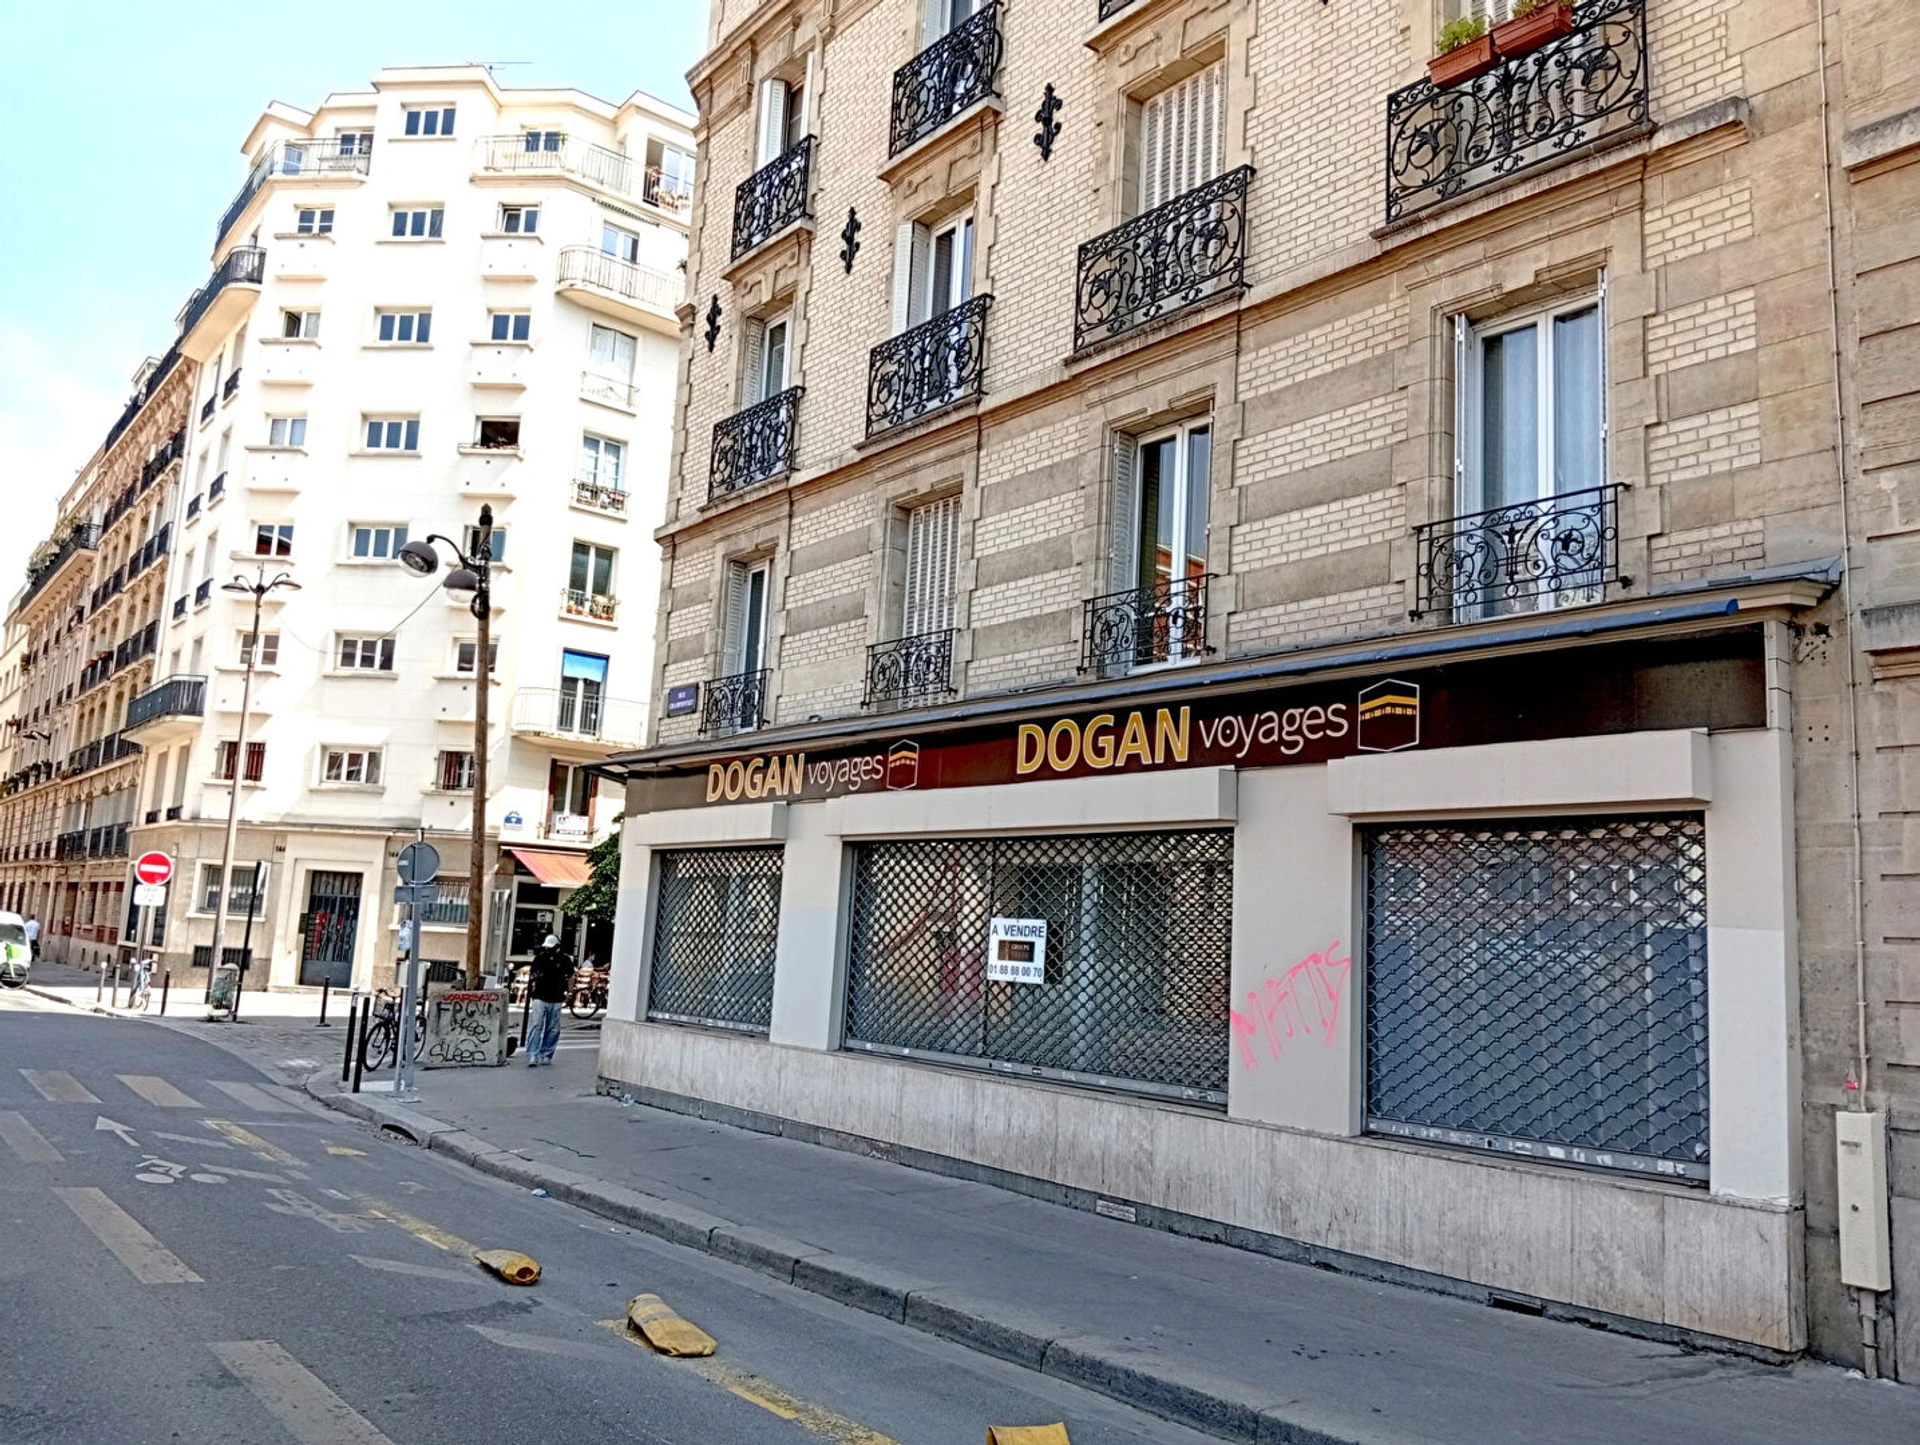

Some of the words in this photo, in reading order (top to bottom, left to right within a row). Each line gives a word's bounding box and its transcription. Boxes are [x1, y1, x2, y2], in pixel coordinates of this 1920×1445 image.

[1016, 706, 1191, 774] DOGAN
[1199, 702, 1349, 758] voyages
[706, 753, 805, 803] DOGAN
[807, 754, 884, 793] voyages
[991, 924, 999, 936] A
[1003, 924, 1045, 938] VENDRE
[988, 963, 998, 975] 01
[999, 964, 1009, 976] 88
[1021, 965, 1032, 977] 00
[1032, 966, 1044, 978] 70
